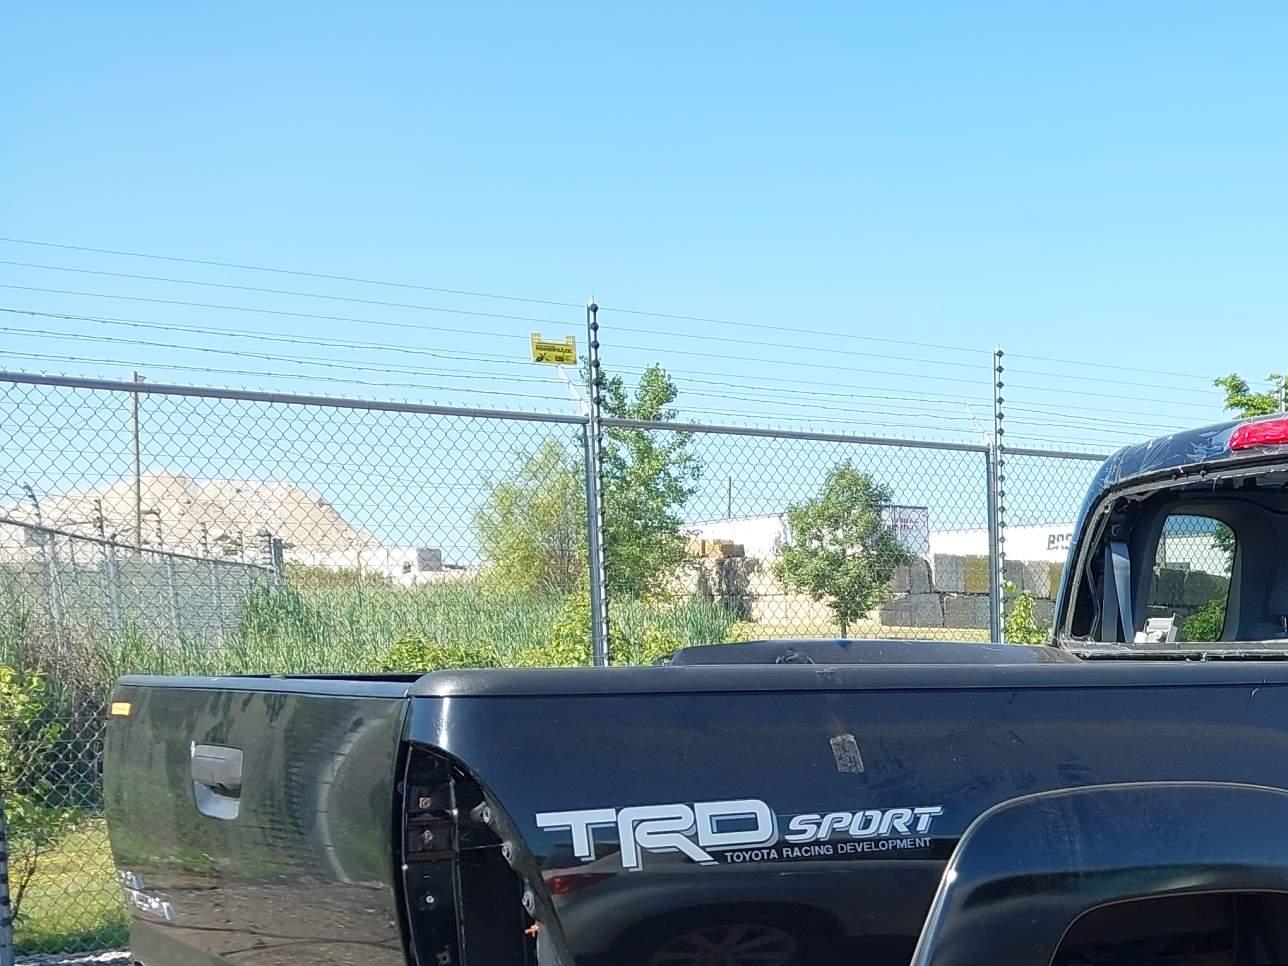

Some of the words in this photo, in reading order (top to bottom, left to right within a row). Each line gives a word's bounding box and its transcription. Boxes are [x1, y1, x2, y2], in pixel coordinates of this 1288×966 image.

[535, 799, 779, 872] TRD
[784, 806, 944, 844] SPORT
[724, 848, 779, 864] TOYOTA
[782, 844, 834, 859] RACING
[837, 837, 932, 856] DEVELOPMENT
